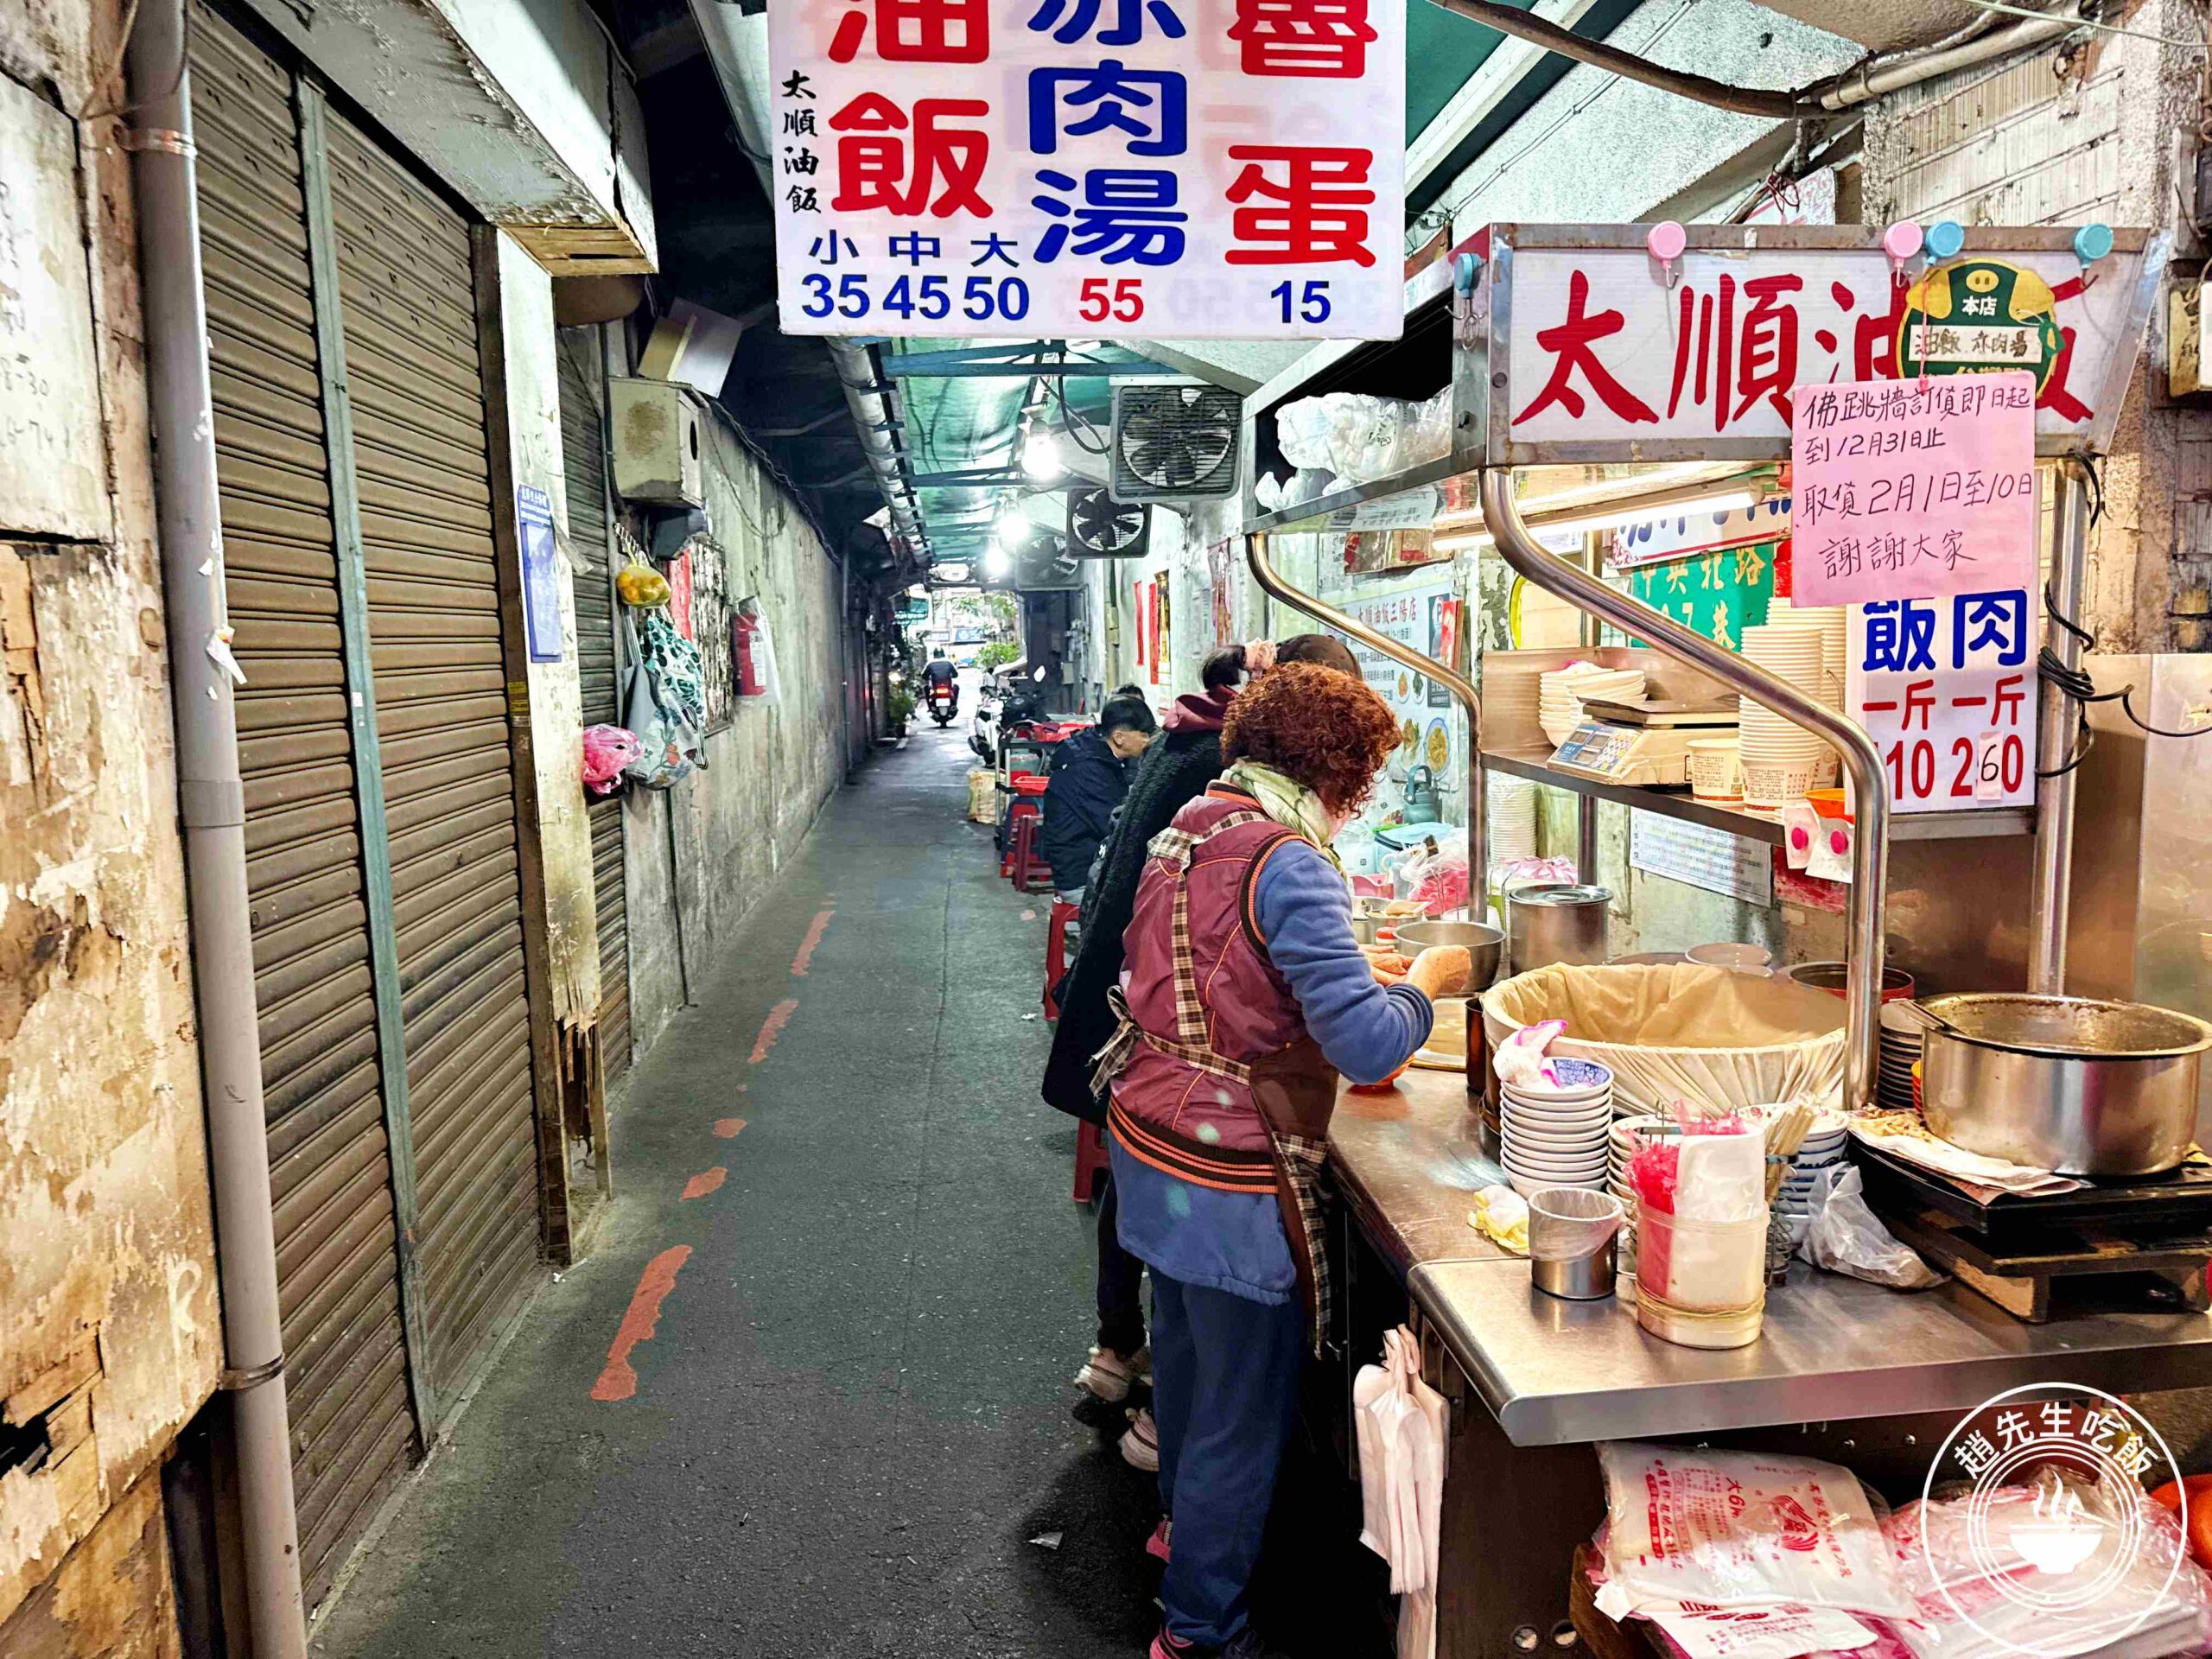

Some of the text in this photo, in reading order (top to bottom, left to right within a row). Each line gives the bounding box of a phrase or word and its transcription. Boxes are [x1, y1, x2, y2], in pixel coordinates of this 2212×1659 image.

[782, 69, 823, 214] 太順油飯
[1224, 0, 1378, 268] 魯蛋
[808, 229, 1020, 267] 小 中 大
[801, 273, 1332, 324] 35 45 50 55 15
[1961, 295, 1998, 317] 本店
[1805, 427, 1946, 466] 到12月31日止
[1819, 529, 1978, 580] 謝謝大家
[1862, 674, 2025, 731] 一斤 一斤
[1873, 734, 2024, 800] 10 260
